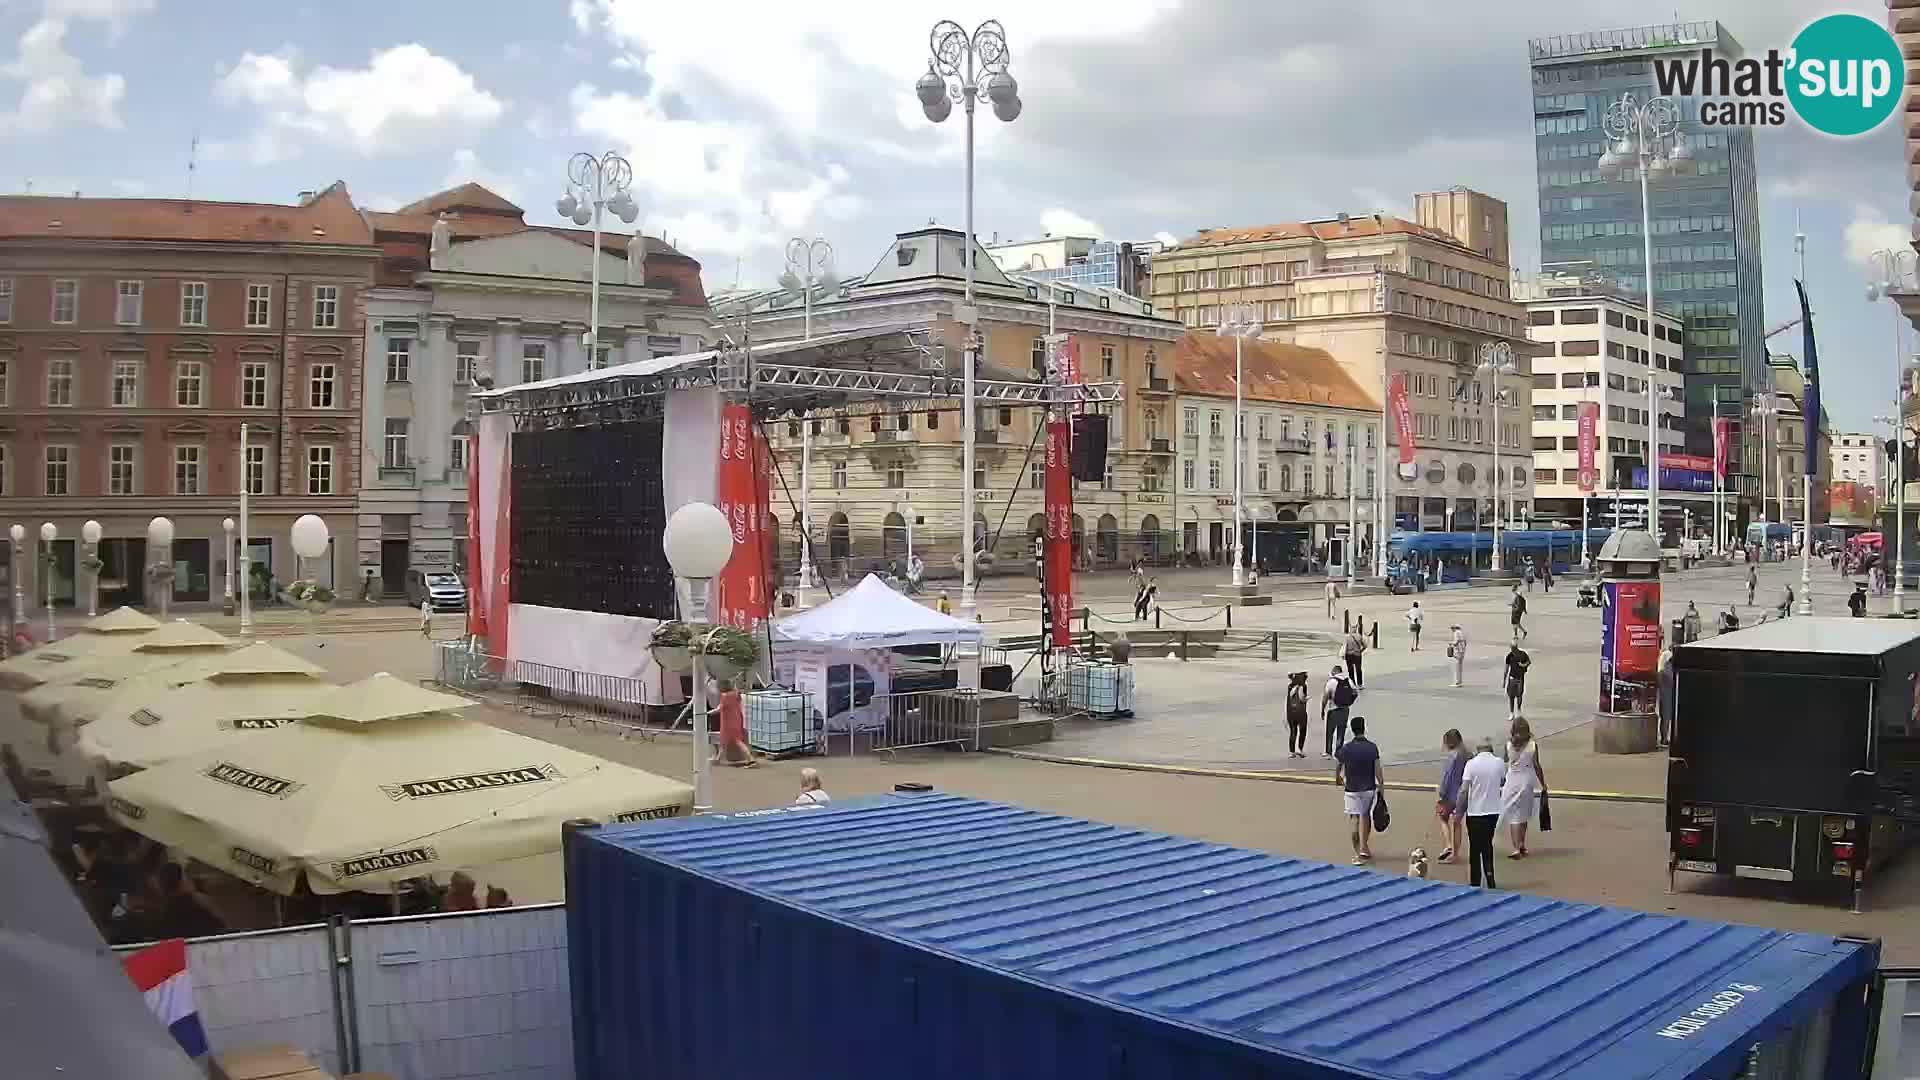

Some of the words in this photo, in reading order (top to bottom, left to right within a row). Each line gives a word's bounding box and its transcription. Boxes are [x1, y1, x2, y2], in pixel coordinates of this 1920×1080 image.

[216, 765, 283, 794] MARASKA
[411, 768, 538, 796] MARASKA
[348, 851, 424, 874] MARASKA
